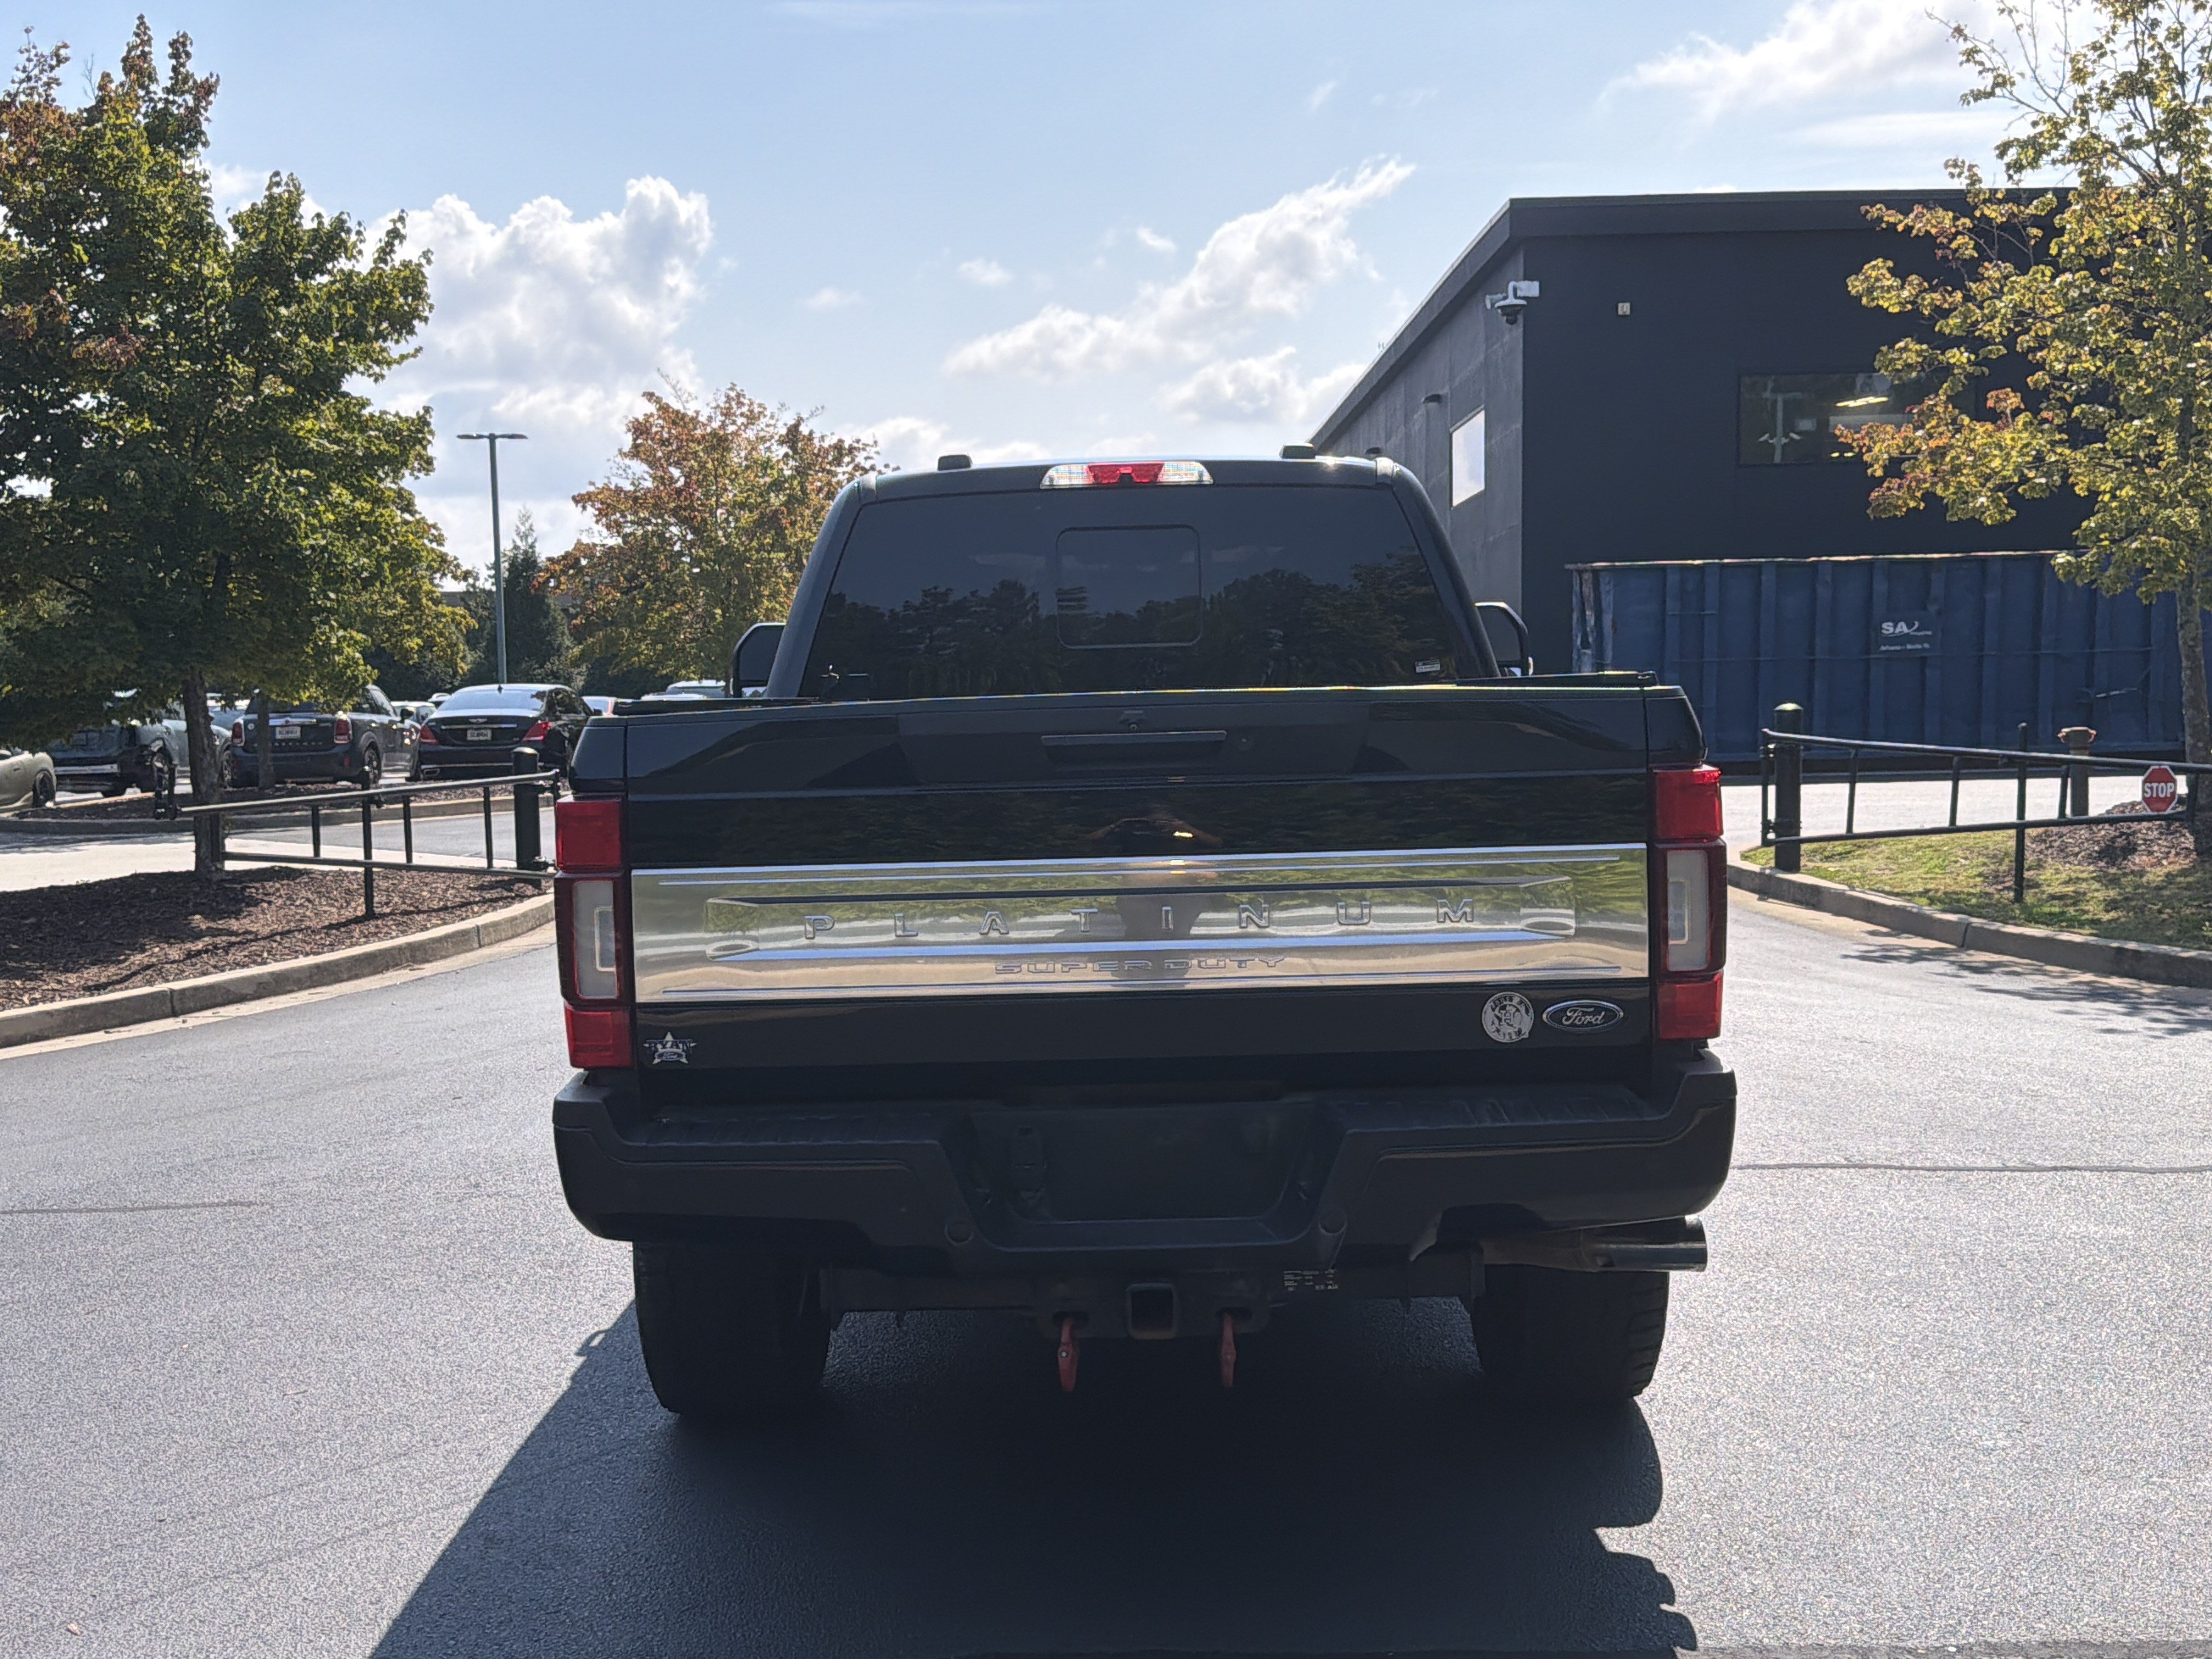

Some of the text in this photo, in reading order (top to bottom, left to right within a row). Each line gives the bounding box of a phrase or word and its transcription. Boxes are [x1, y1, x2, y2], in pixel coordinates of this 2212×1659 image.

[2143, 782, 2175, 798] STOP
[804, 898, 1474, 940] PLATINUM
[995, 956, 1285, 974] SUPER DUTY
[1562, 1007, 1606, 1025] Ford
